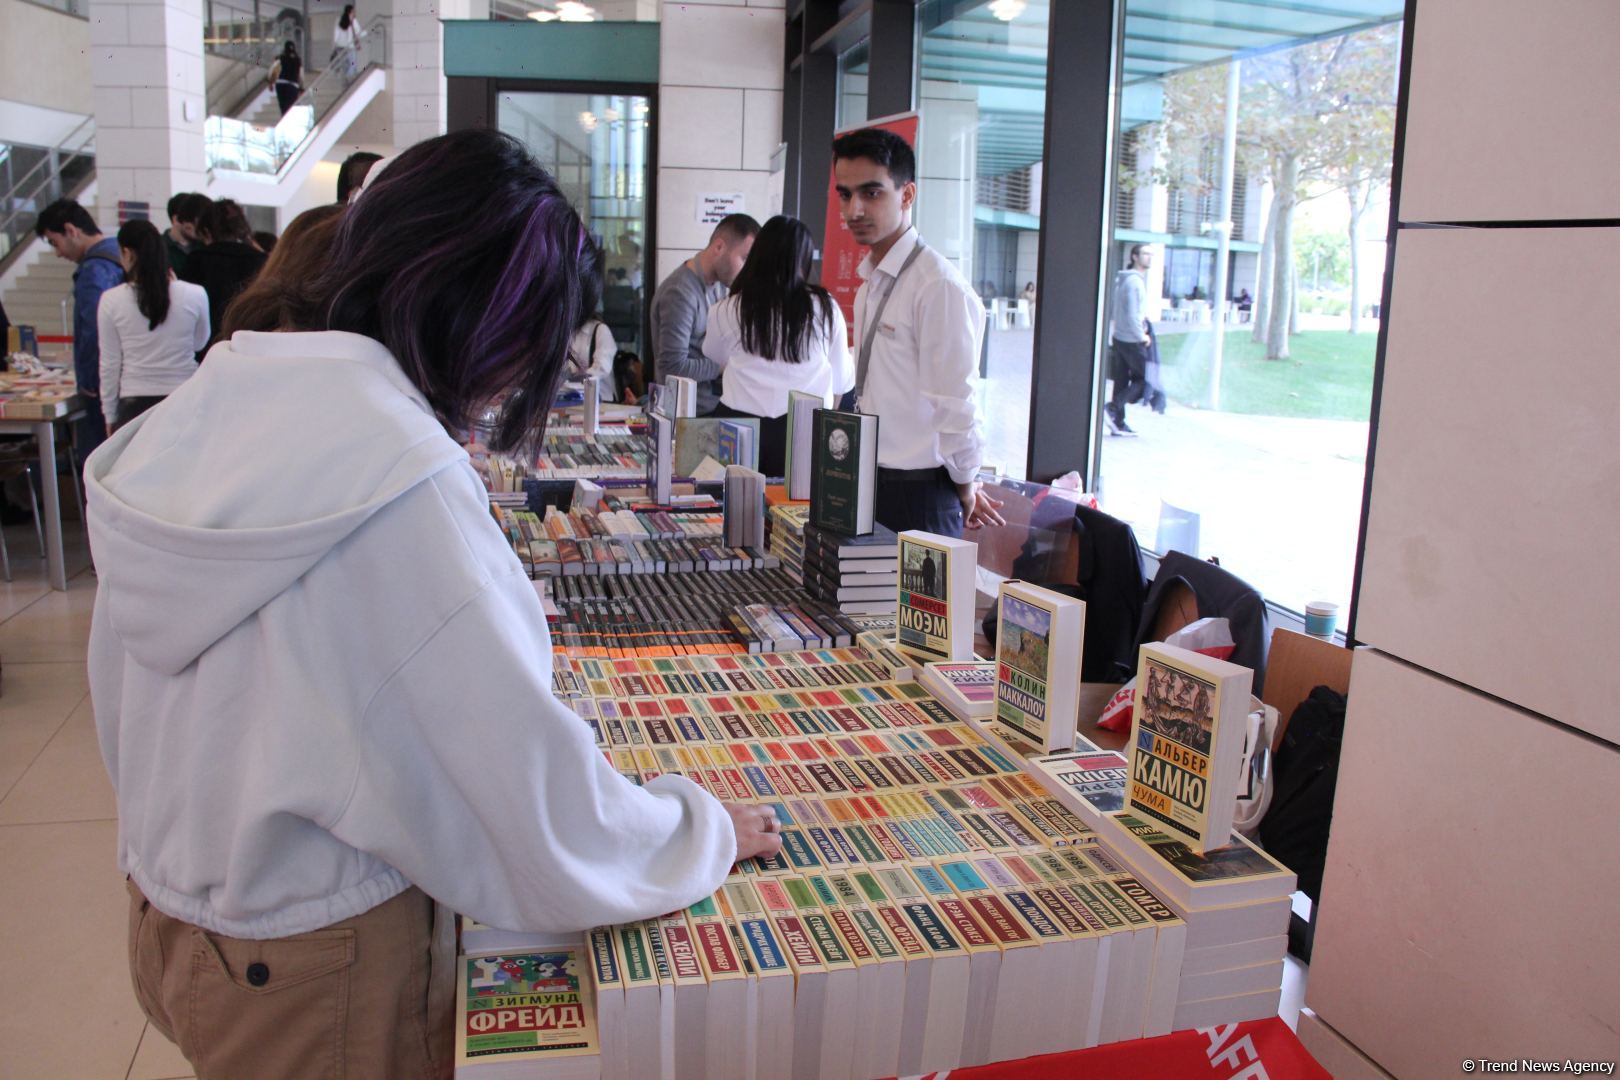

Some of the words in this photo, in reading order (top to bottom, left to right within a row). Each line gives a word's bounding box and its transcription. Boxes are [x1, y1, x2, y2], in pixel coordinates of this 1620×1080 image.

[901, 606, 947, 639] МОЭМ
[1010, 671, 1046, 700] КОЛИН
[999, 683, 1045, 718] МАККАЛОУ
[1154, 740, 1207, 773] АЛЬБЕР
[1135, 751, 1204, 808] КАМЮ
[1133, 785, 1165, 811] ЧУМА
[819, 840, 840, 861] ФРОММ
[1040, 855, 1067, 872] 1984
[1062, 853, 1089, 868] 1984
[1086, 849, 1117, 870] ОДИССЕЯ
[833, 877, 855, 896] 1984
[919, 868, 944, 890] ДРАКУЛА
[1036, 890, 1060, 907] ОСКАР
[1053, 908, 1083, 930] УАЙЛЬД
[1057, 888, 1075, 900] КУРТ
[1069, 901, 1102, 928] ВОННЕГУТ
[1089, 901, 1117, 923] ОРУЭЛЛ
[1110, 898, 1141, 920] ОРУЭЛЛ
[1119, 883, 1170, 916] ГОМЕР
[909, 905, 934, 926] ФРАНЦ
[925, 926, 950, 948] КАФКА
[943, 902, 965, 918] БРЭМ
[958, 919, 985, 942] СТОКЕР
[977, 897, 1003, 918] ВИНСЕНТ
[996, 919, 1012, 929] ВАН
[1006, 930, 1022, 938] ГОГ
[1019, 905, 1056, 934] ЛОНДОН
[704, 925, 721, 945] ГЮСТАВ
[749, 921, 767, 945] ФРИДРИХ
[760, 946, 777, 966] НИЦШЕ
[785, 930, 818, 962] ХЕЙЛИ
[809, 916, 831, 938] СТЕФАН
[822, 939, 844, 959] ЦВЕЙГ
[832, 912, 852, 930] ПАУЛО
[845, 932, 868, 955] КОЭЛЬО
[867, 929, 891, 952] ОРУЭЛЛ
[891, 926, 922, 951] ФРЕЙД
[672, 940, 698, 974] ХЕЙЛИ
[712, 946, 730, 969] ФЛОБЕР
[602, 966, 612, 980] ВУЛФ
[496, 993, 579, 1007] ЗИГМУНД
[469, 1004, 582, 1032] ФРЕЙД
